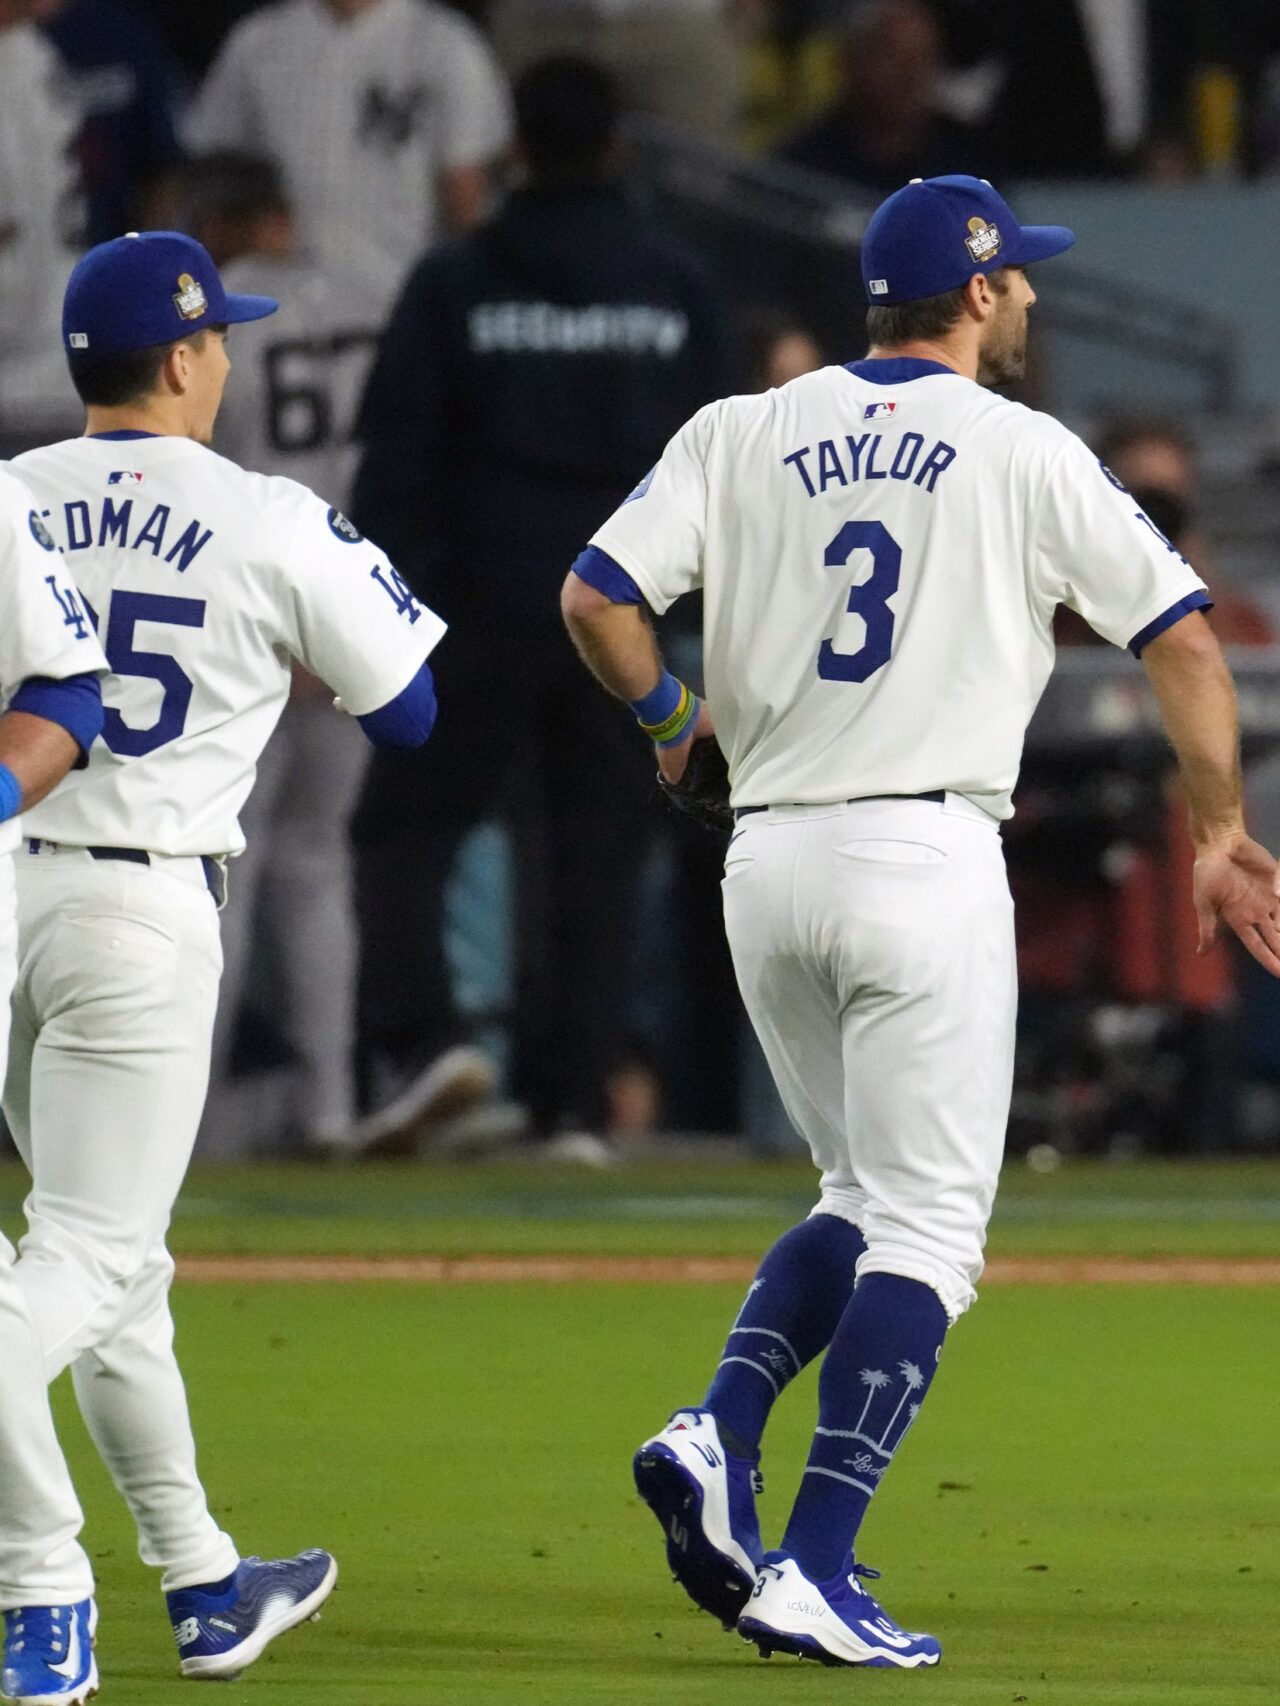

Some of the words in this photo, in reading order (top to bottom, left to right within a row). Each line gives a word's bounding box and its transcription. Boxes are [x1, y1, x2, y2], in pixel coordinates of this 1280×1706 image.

[783, 432, 956, 497] TAYLOR
[42, 497, 214, 573] DMAN
[370, 564, 421, 624] LA
[817, 520, 903, 683] 3
[77, 588, 207, 757] 5
